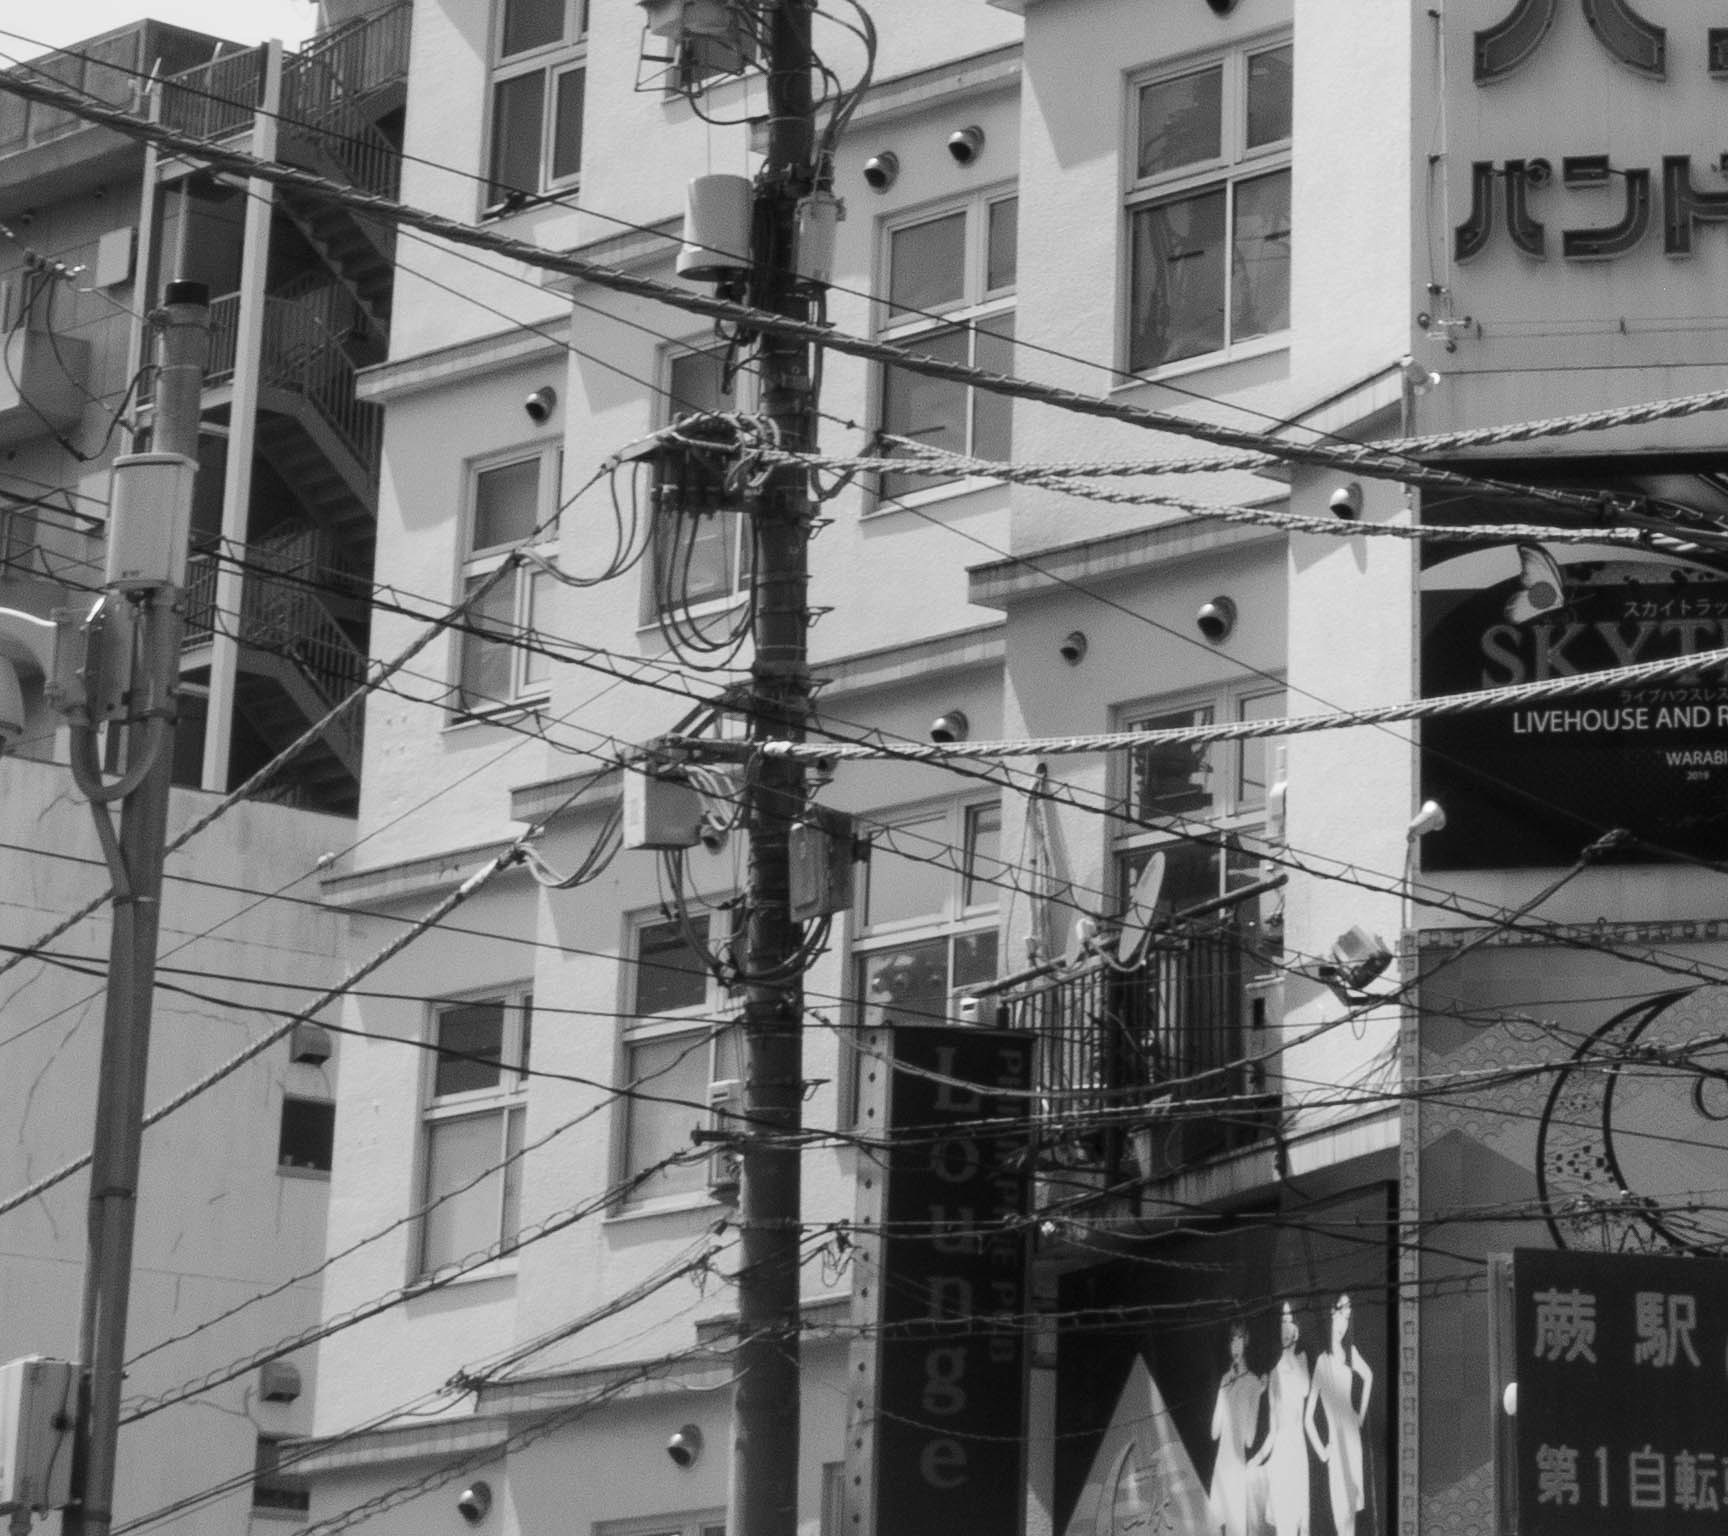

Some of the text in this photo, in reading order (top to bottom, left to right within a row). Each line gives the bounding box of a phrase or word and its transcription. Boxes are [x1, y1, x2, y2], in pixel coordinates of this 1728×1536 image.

[1513, 706, 1649, 733] LIVEHOUSE
[1656, 705, 1711, 729] AND
[1665, 750, 1728, 767] WARABI
[1533, 1288, 1701, 1367] 蕨駅
